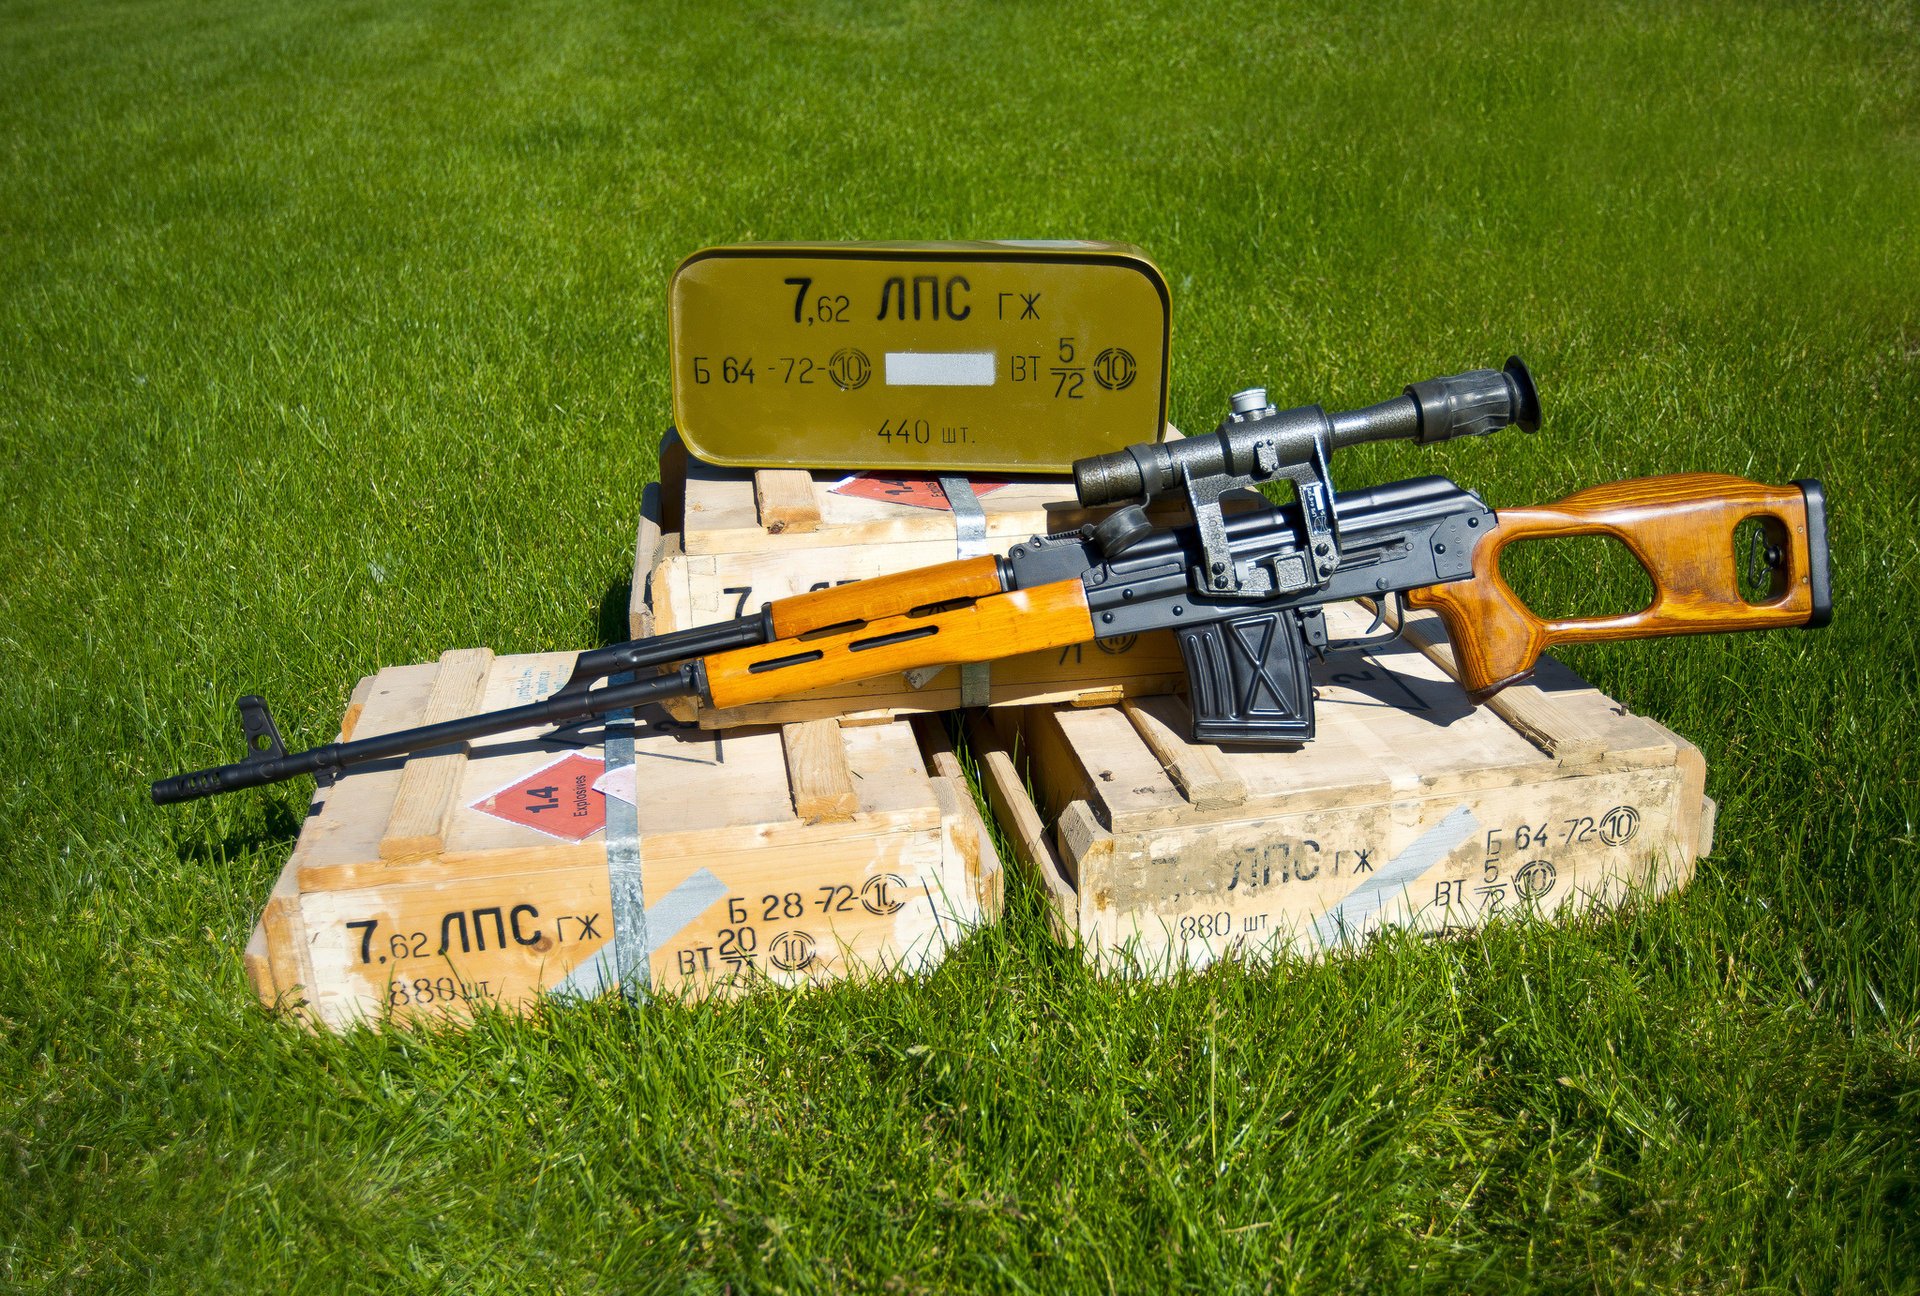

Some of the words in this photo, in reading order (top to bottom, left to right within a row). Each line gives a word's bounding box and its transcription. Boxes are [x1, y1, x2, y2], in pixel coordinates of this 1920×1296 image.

[784, 277, 850, 326] 7,62
[876, 275, 972, 321] ЛПС
[998, 293, 1041, 320] ГЖ
[1059, 337, 1075, 363] 5
[694, 357, 710, 384] Б
[722, 356, 755, 384] 64
[1011, 355, 1041, 382] ВТ
[1051, 372, 1084, 399] 72
[877, 419, 930, 444] 440
[526, 786, 558, 813] 1.4
[573, 775, 590, 817] Explosives
[1487, 829, 1502, 856] Б
[1515, 823, 1548, 850] 64
[1434, 879, 1466, 907] ВТ
[728, 897, 747, 924] Б
[762, 892, 804, 921] 28
[346, 919, 430, 965] 7,62
[437, 904, 542, 956] ЛПС
[557, 913, 602, 942] ГЖ
[1180, 911, 1231, 941] 880
[677, 946, 713, 976] ВТ
[718, 926, 756, 956] 20
[389, 977, 456, 1006] 880
